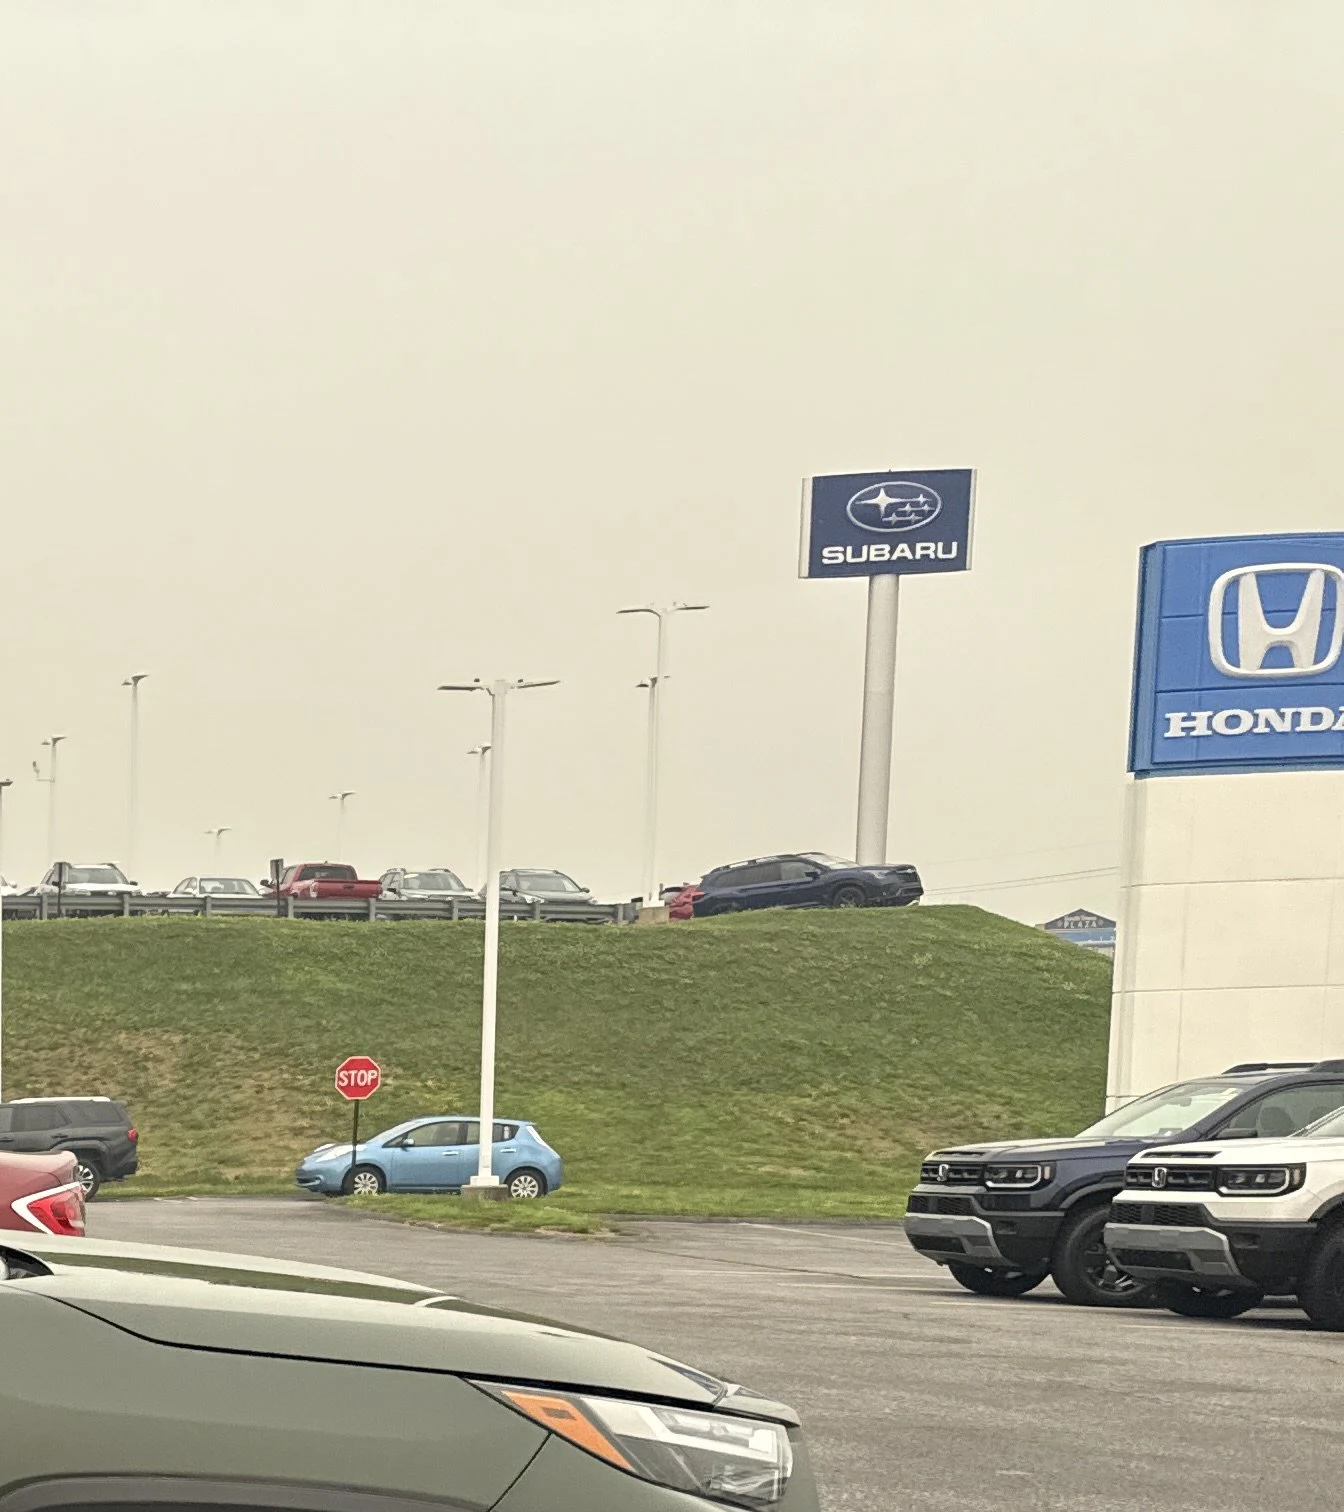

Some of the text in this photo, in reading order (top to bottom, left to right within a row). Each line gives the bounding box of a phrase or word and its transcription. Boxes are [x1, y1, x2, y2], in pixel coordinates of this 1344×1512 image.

[821, 541, 958, 565] SUBARU
[1063, 920, 1097, 929] PLAZA
[338, 1069, 378, 1087] STOP
